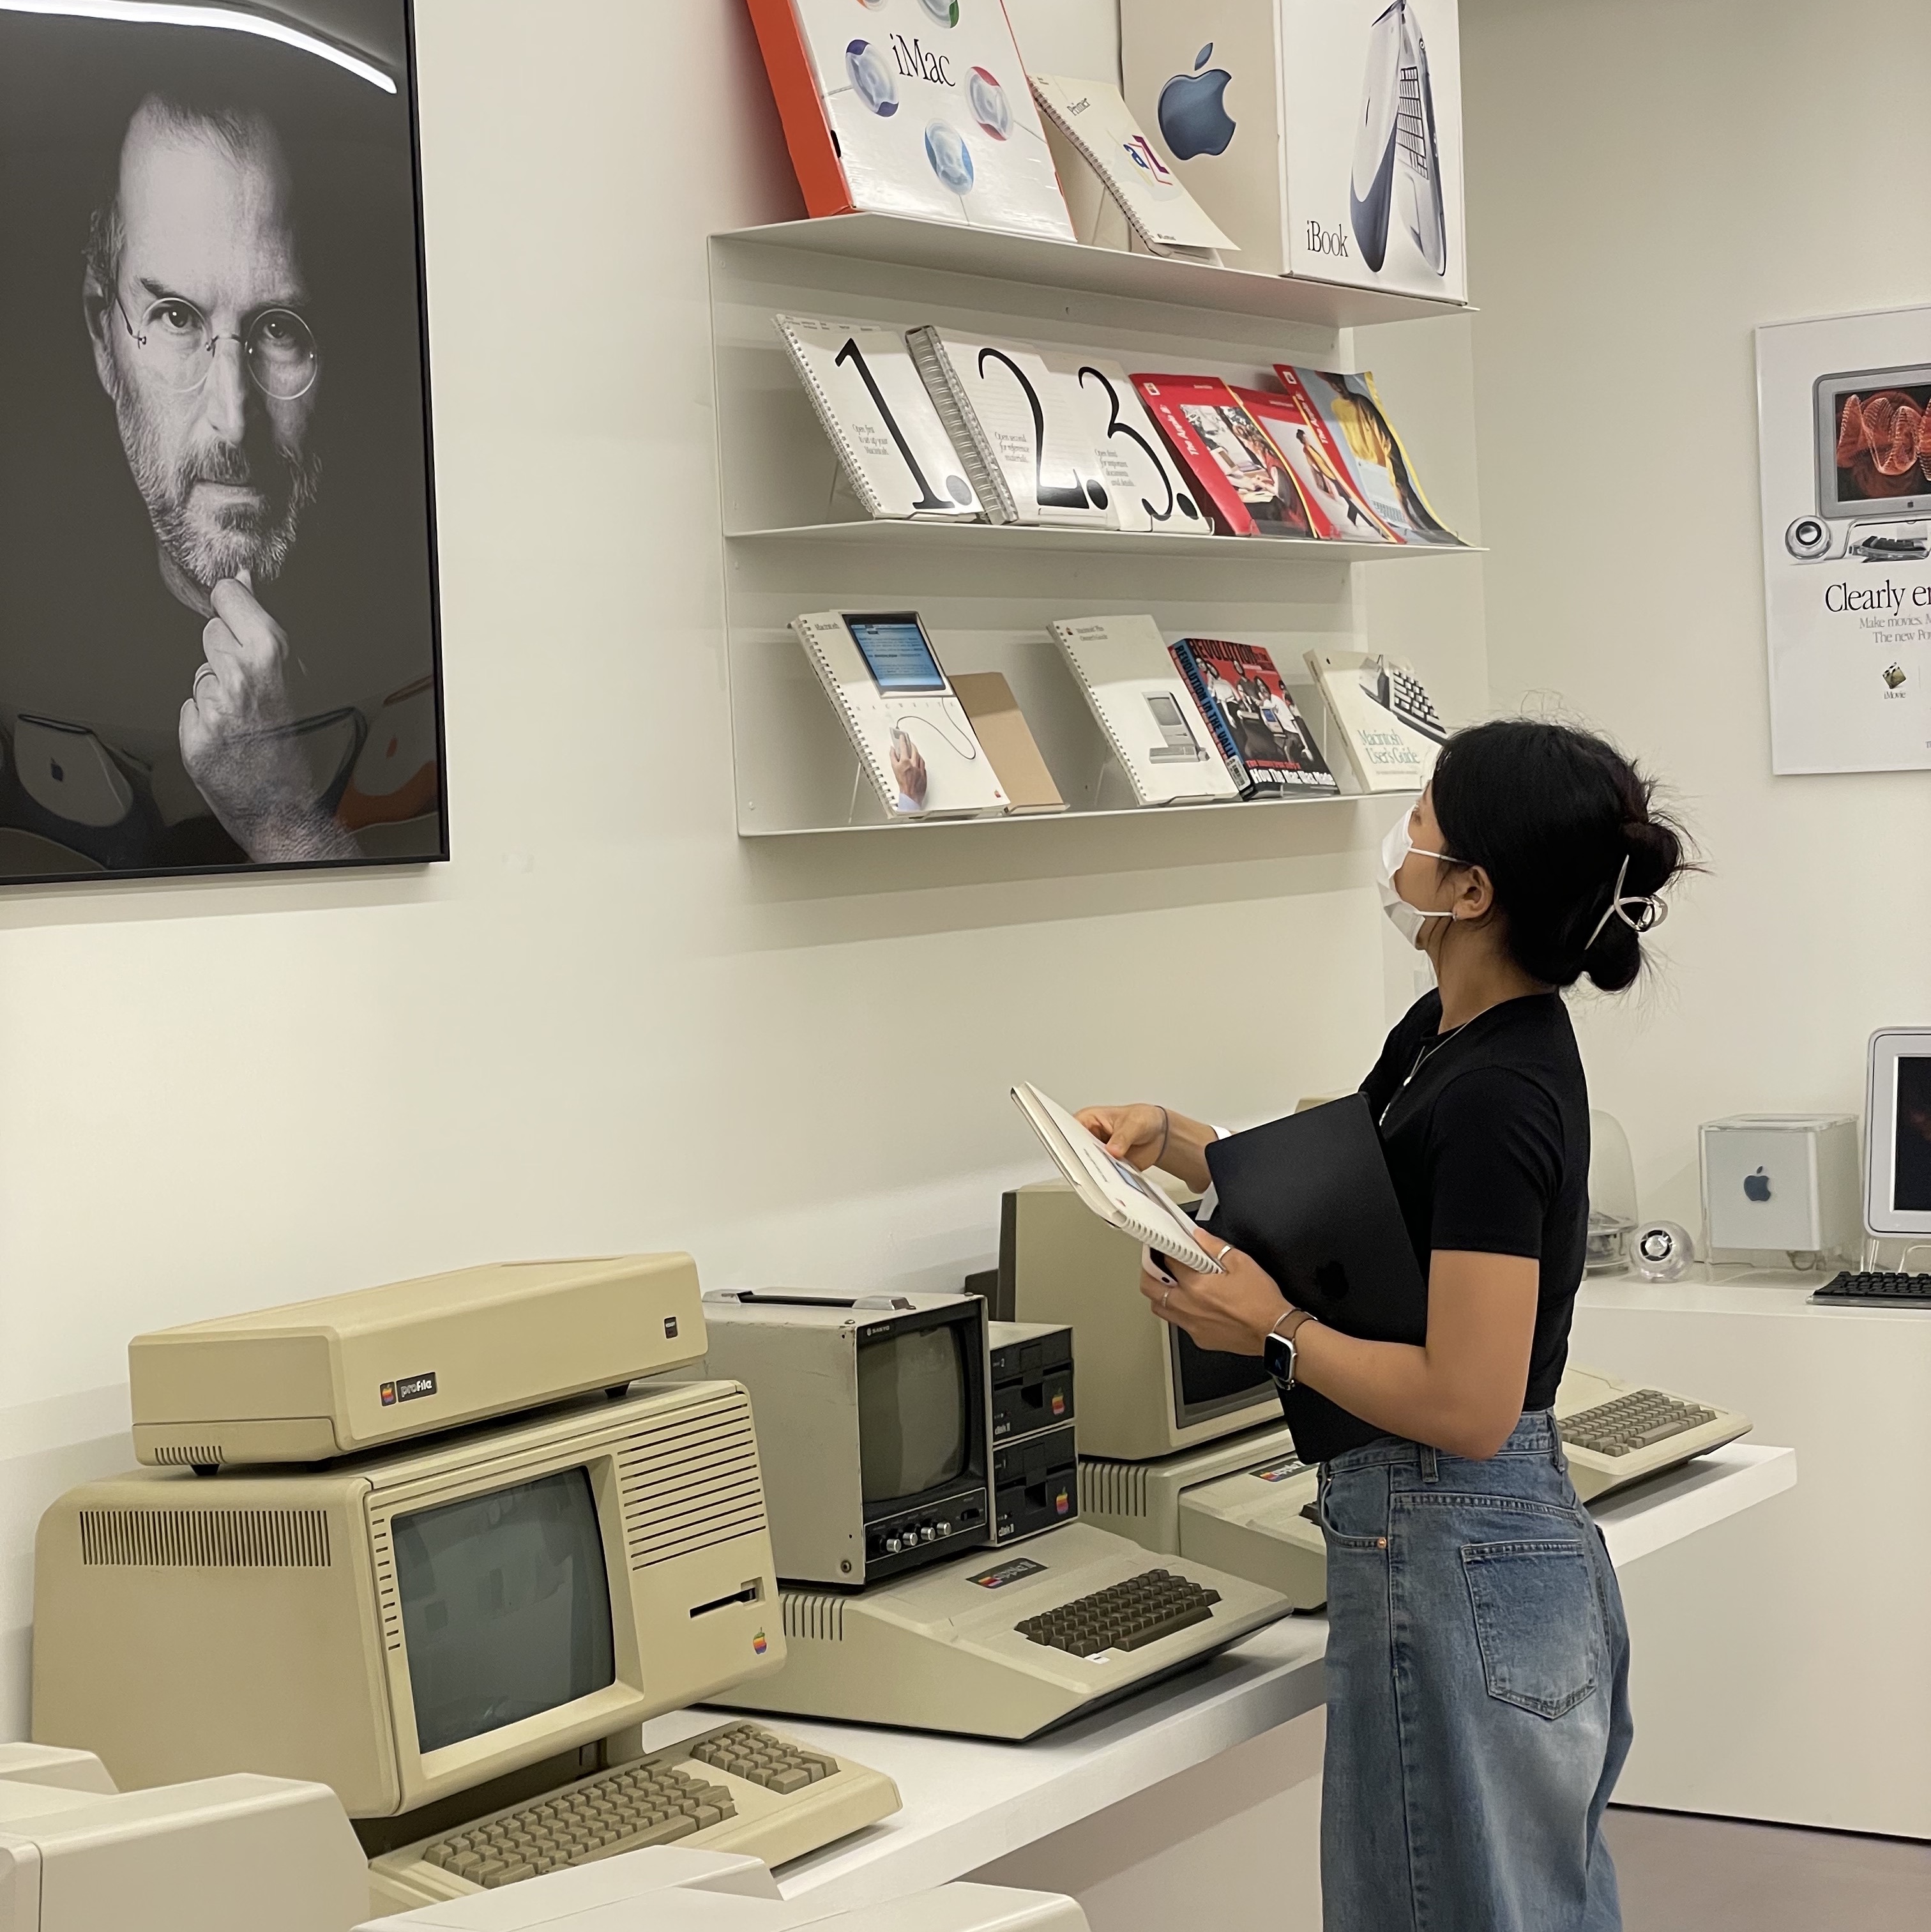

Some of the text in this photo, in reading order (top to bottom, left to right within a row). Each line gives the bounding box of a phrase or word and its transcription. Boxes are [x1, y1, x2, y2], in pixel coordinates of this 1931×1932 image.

[890, 33, 956, 87] iMac
[1306, 220, 1349, 257] iBook
[1825, 579, 1906, 616] Clearly
[1859, 616, 1885, 629] Make
[1873, 630, 1893, 643] The
[1895, 631, 1916, 643] new
[1175, 644, 1208, 701] REVOLUTION
[1884, 691, 1906, 699] iMovie
[1357, 728, 1404, 746] Macintosh
[1366, 747, 1420, 764] User's Guide
[1271, 1463, 1301, 1476] apple
[994, 1565, 1029, 1579] apple
